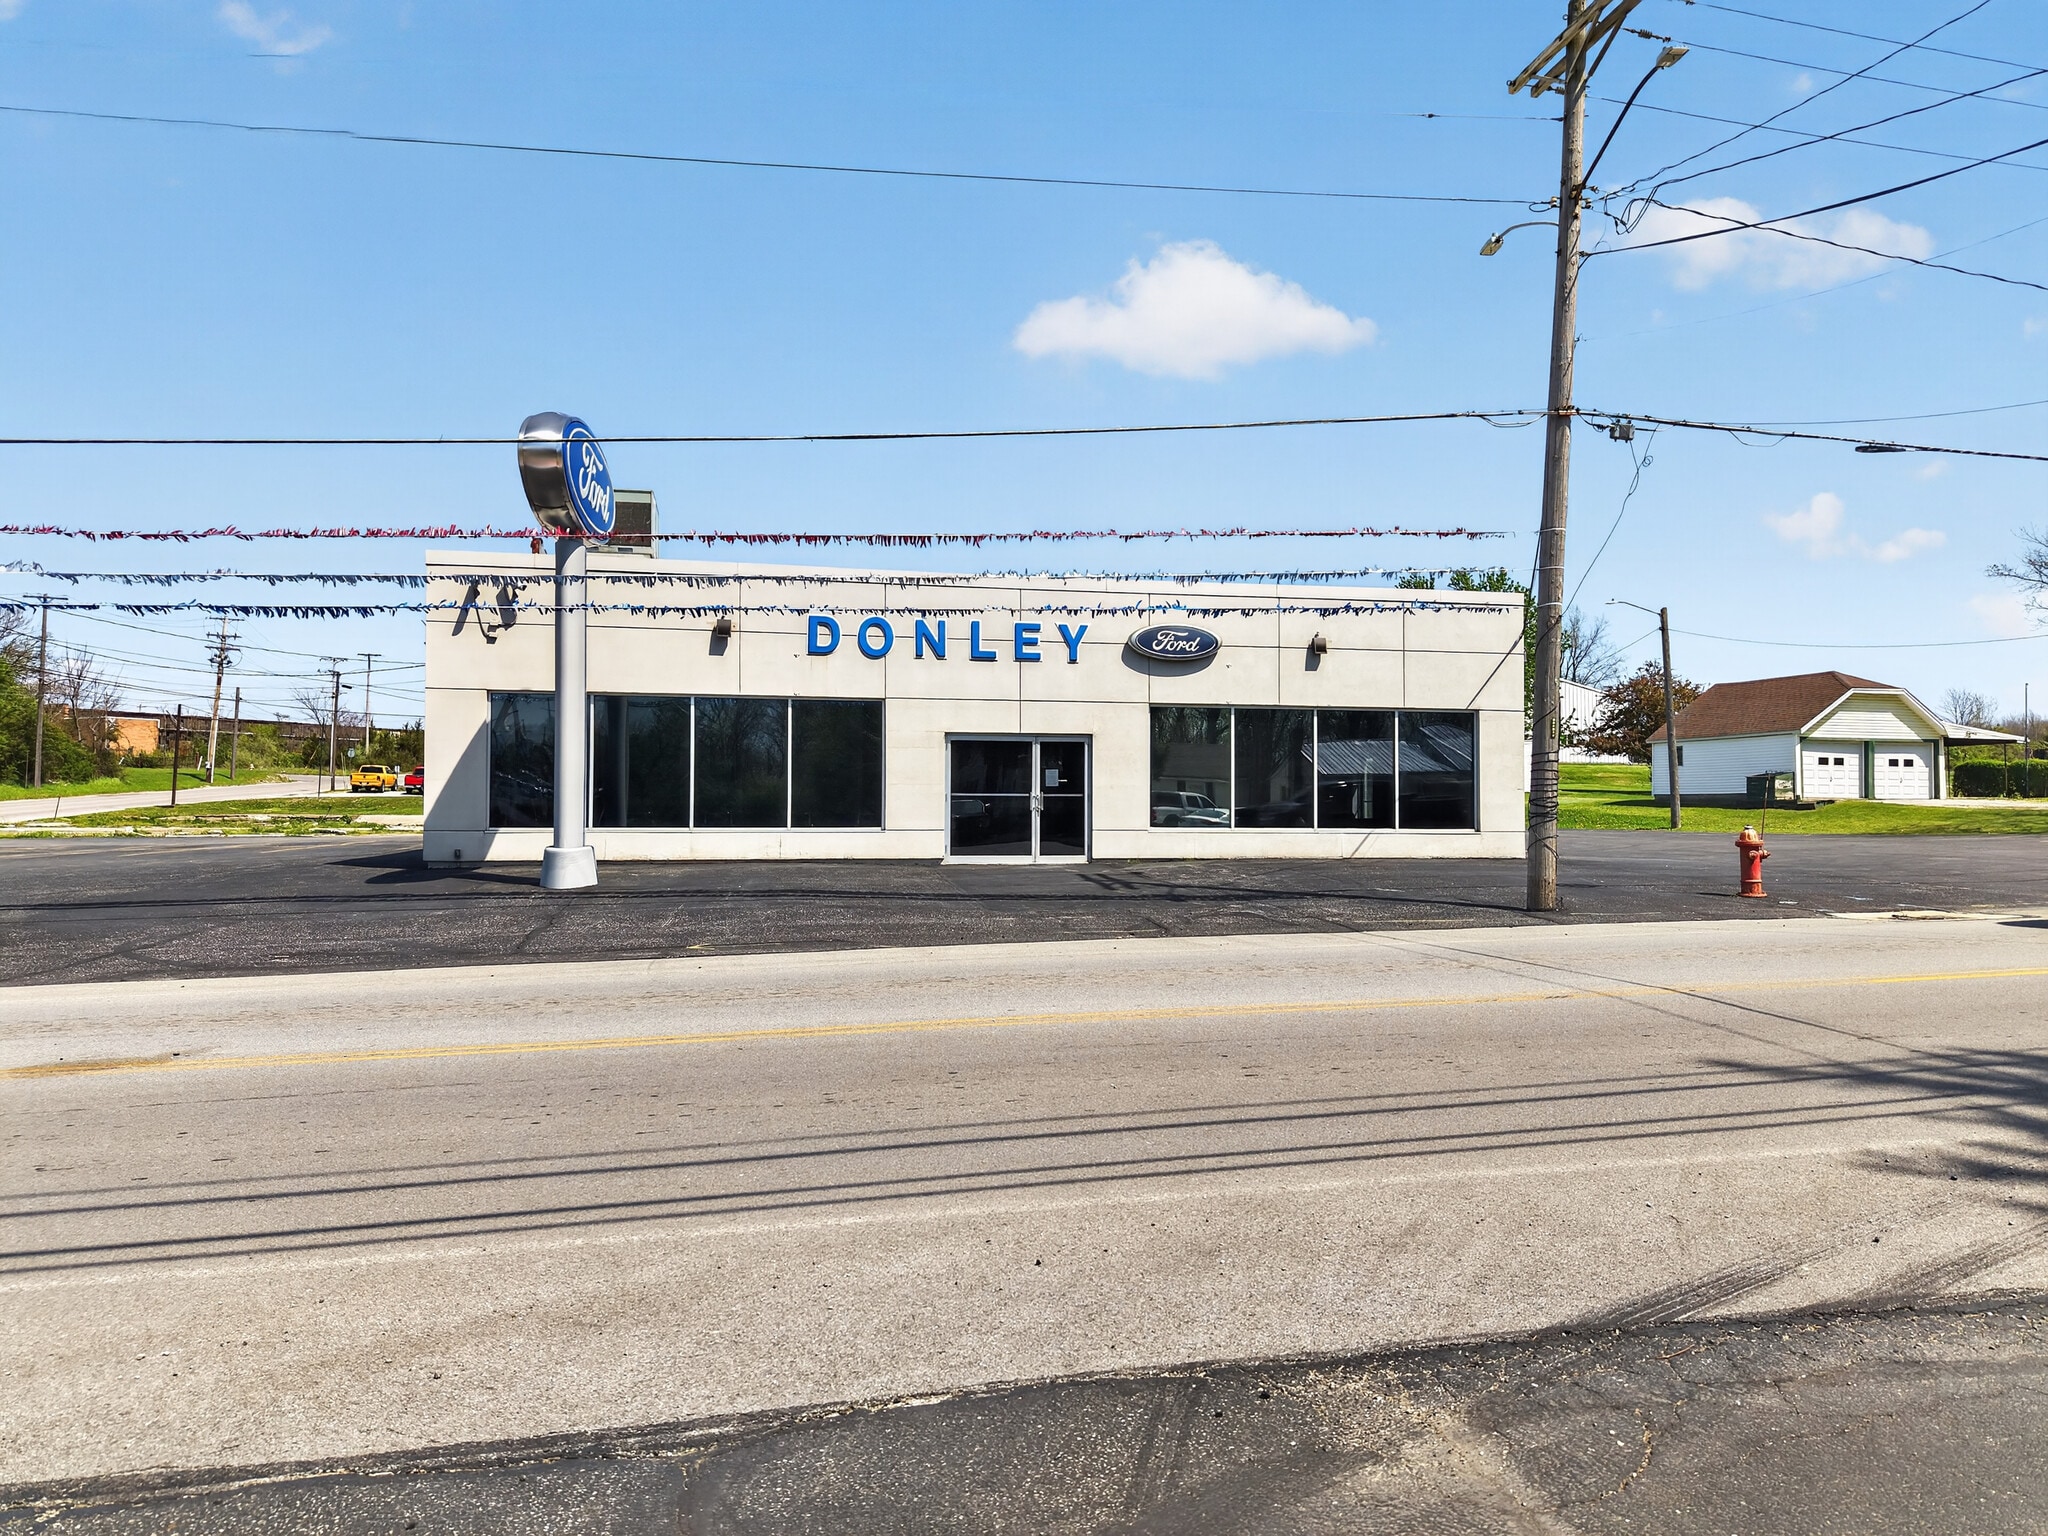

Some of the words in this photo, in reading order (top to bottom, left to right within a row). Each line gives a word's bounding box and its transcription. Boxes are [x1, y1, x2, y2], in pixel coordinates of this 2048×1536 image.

[578, 441, 610, 524] Ford
[807, 615, 1088, 662] DONLEY
[1152, 630, 1201, 652] Ford
